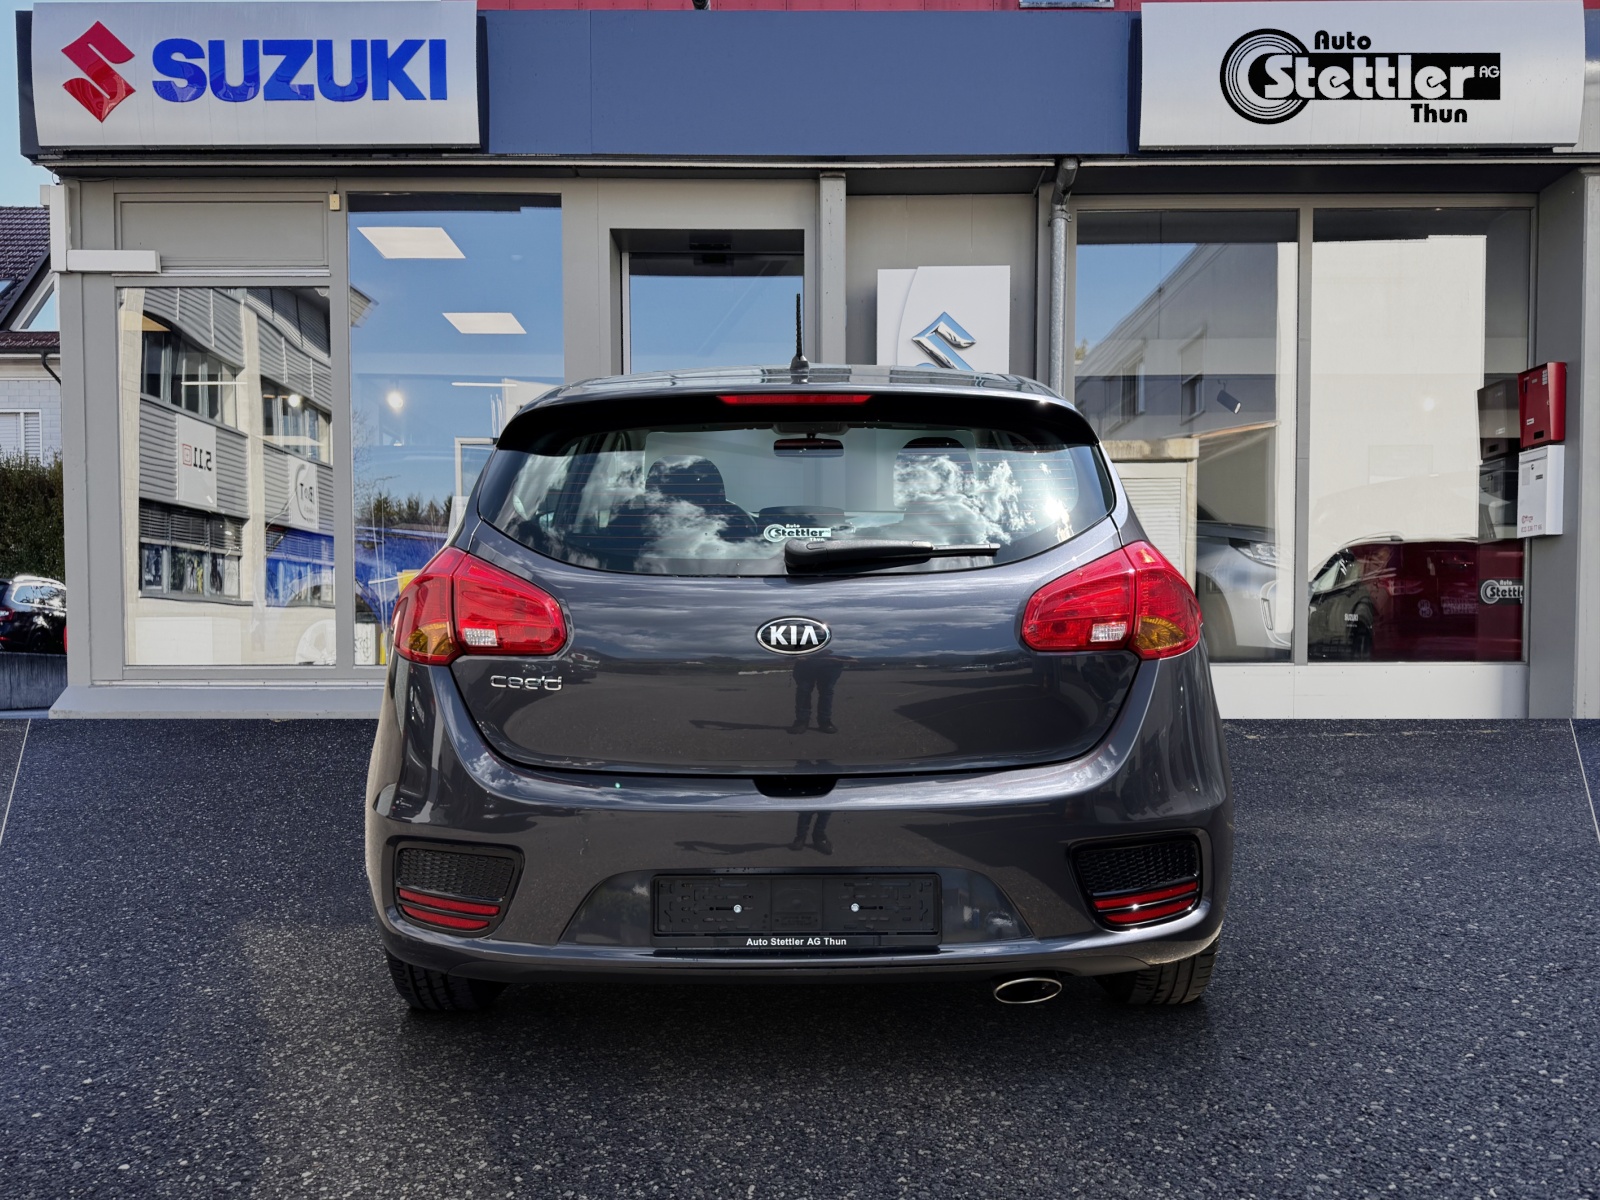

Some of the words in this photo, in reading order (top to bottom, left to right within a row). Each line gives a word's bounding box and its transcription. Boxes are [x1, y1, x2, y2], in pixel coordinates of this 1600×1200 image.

[1314, 30, 1372, 50] Auto
[152, 38, 448, 102] SUZUKI
[1264, 54, 1476, 100] Stettler
[1479, 66, 1500, 79] AG
[1410, 103, 1468, 123] Thun
[774, 528, 825, 537] Stettler
[769, 625, 819, 645] KIA
[490, 675, 563, 691] cee'd
[746, 938, 768, 946] Auto
[770, 937, 804, 946] Stettler
[806, 937, 821, 946] AG
[823, 937, 847, 946] Thun
